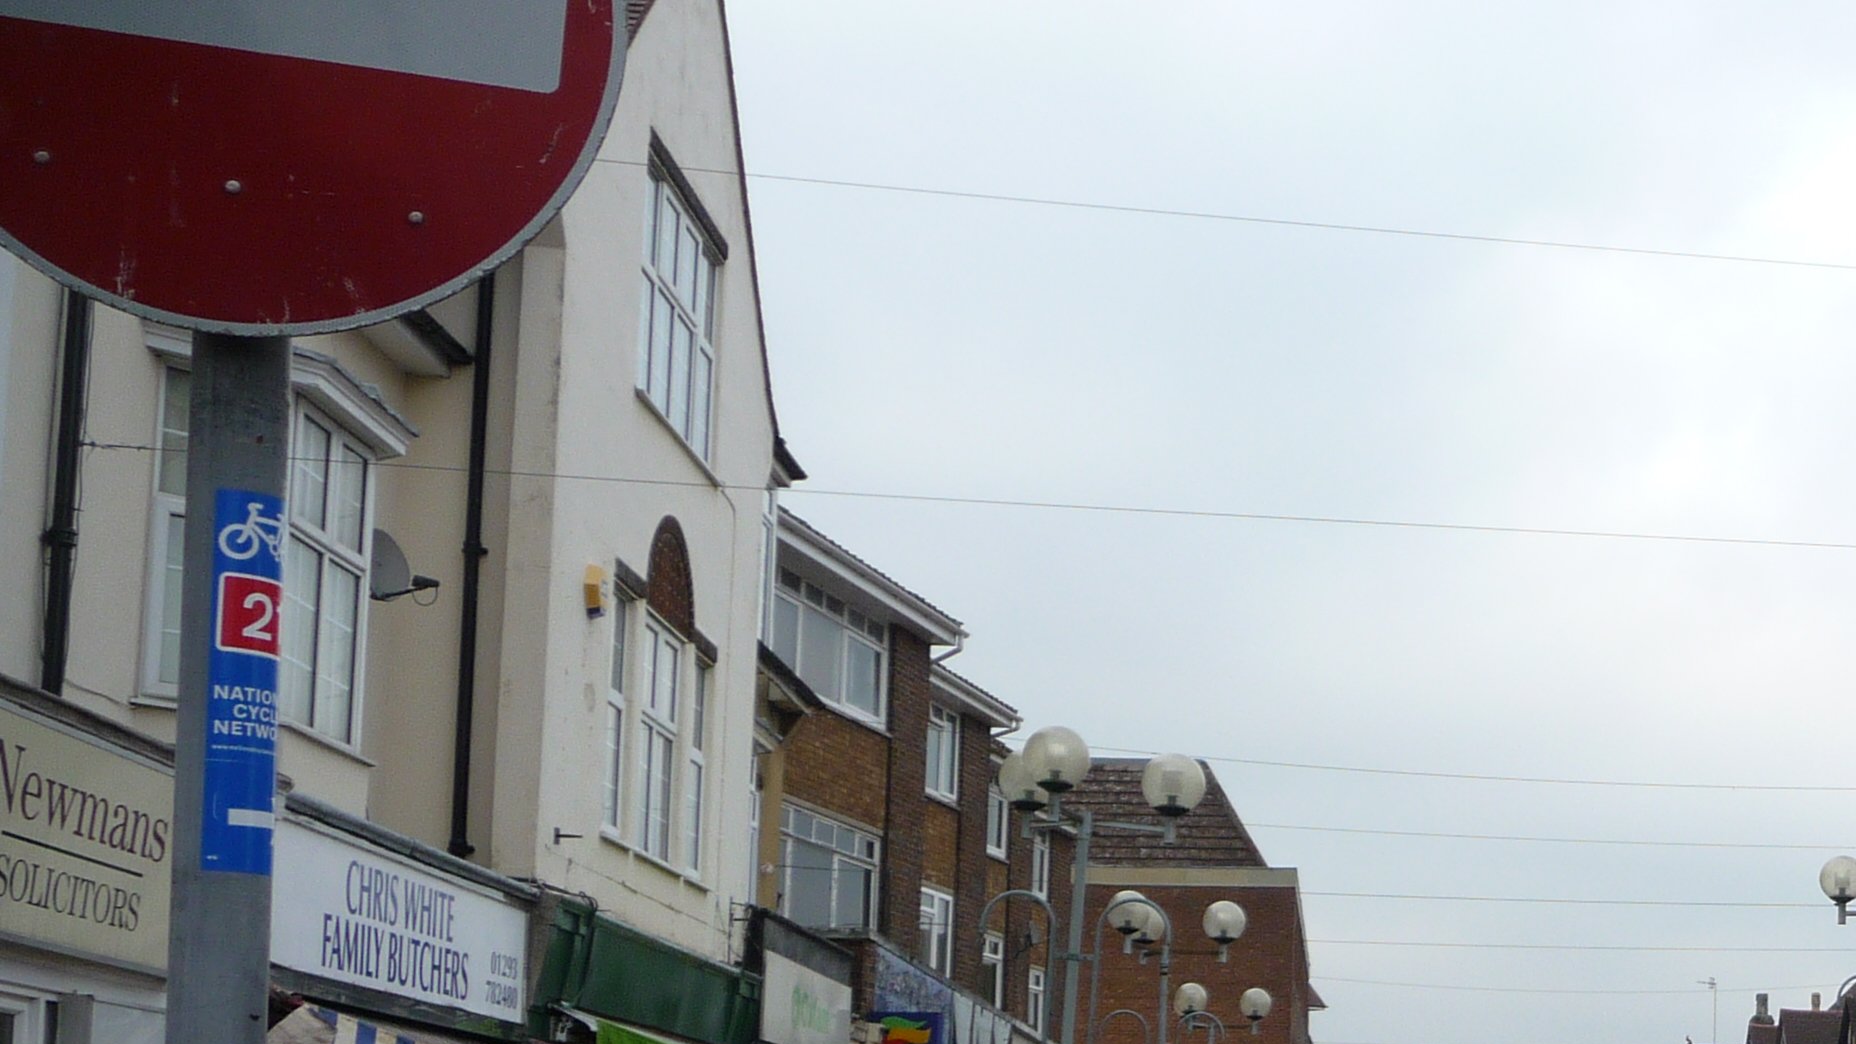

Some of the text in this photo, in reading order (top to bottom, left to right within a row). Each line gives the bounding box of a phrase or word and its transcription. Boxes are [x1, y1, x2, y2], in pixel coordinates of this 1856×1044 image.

[213, 684, 278, 705] NATIO
[346, 860, 455, 943] CHRIS WHITE
[321, 912, 469, 1000] FAMILY BUTCHERS
[490, 951, 518, 980] 01293
